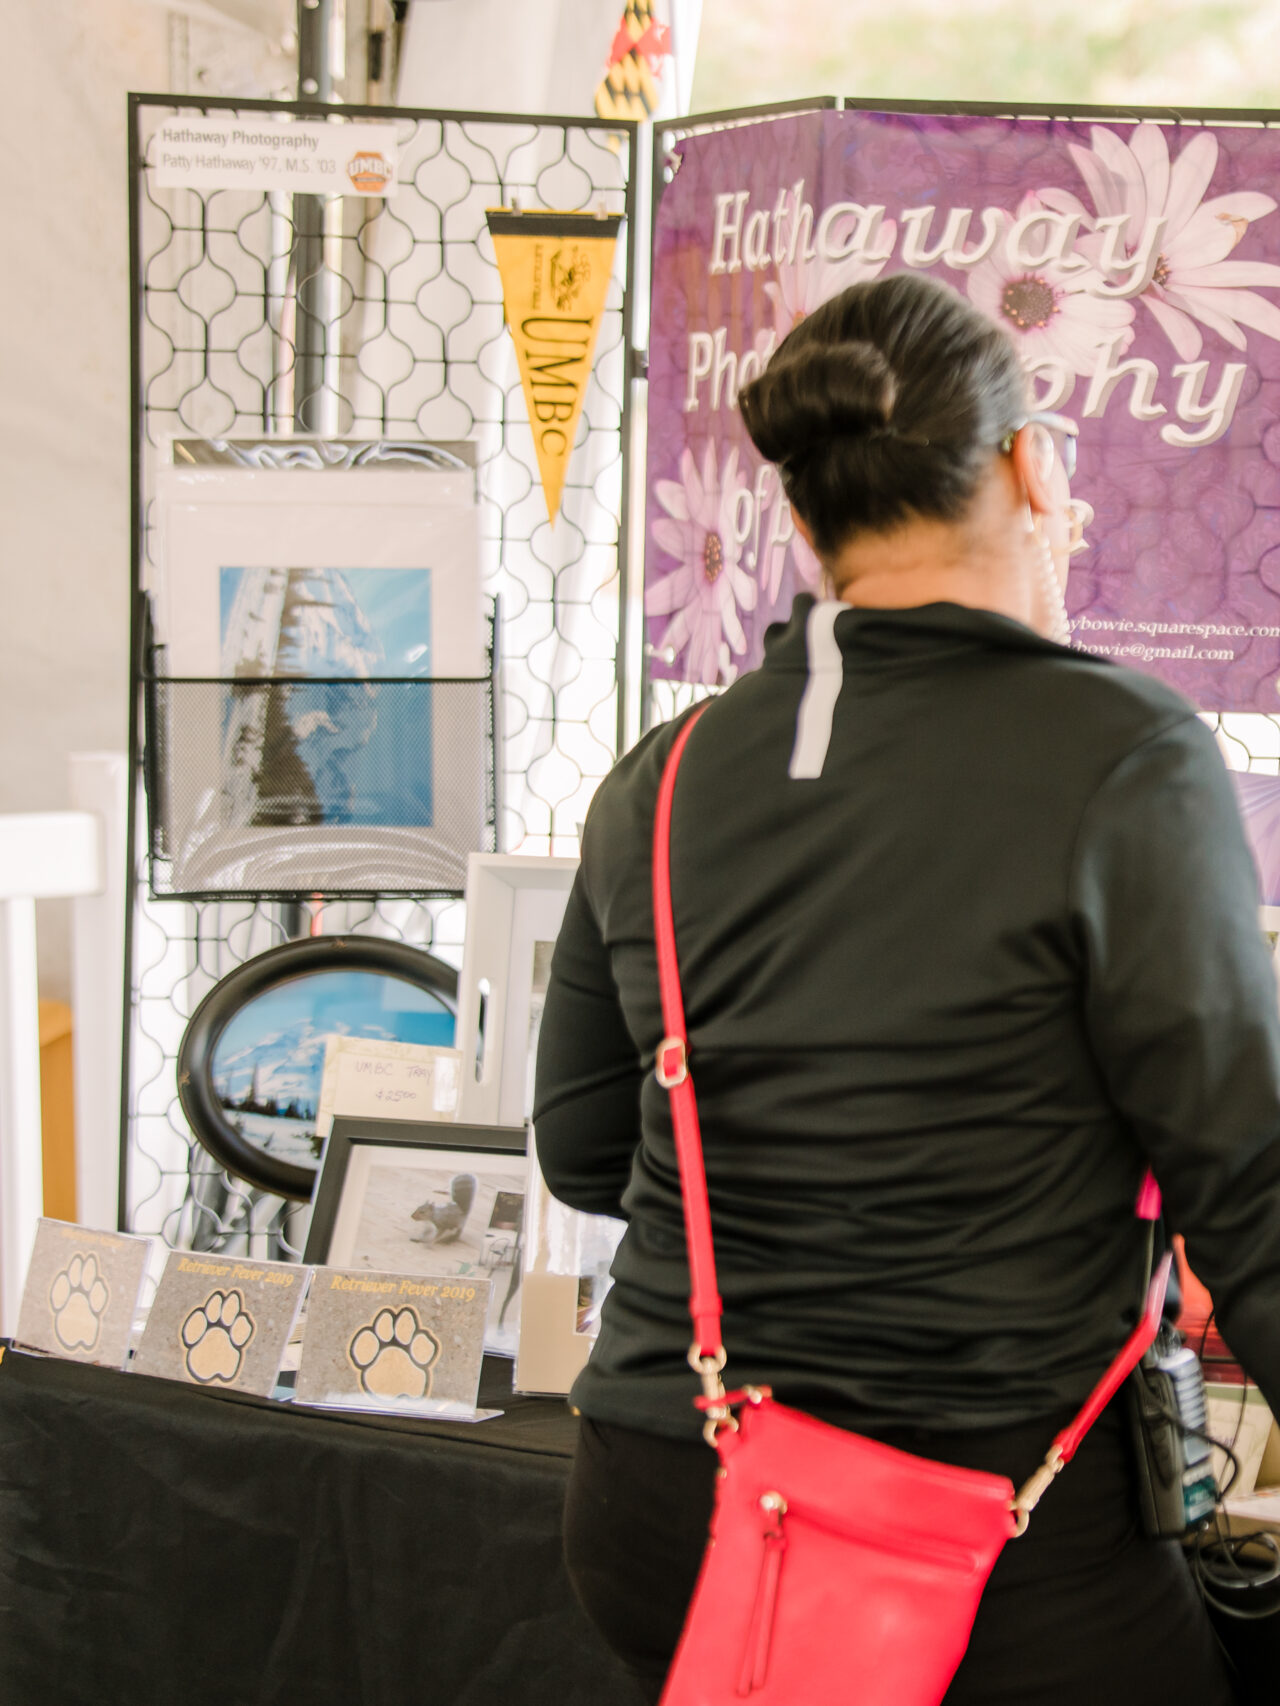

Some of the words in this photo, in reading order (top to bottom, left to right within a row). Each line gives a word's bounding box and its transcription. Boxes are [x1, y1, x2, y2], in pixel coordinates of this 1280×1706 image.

[162, 128, 229, 146] Hathaway
[232, 130, 319, 152] Photography
[162, 153, 192, 171] Patty
[195, 155, 255, 172] Hathaway
[286, 158, 314, 173] M.S.
[316, 159, 337, 174] '03
[708, 178, 1170, 300] Hathaway
[520, 314, 594, 457] UMBC
[733, 463, 772, 572] of
[1070, 640, 1235, 662] bowie@gmail.com
[177, 1258, 229, 1278] Retriever
[230, 1264, 265, 1281] Fever
[265, 1270, 294, 1288] 2019
[330, 1274, 397, 1294] Retriever
[399, 1279, 439, 1297] Fever
[440, 1285, 476, 1301] 2019
